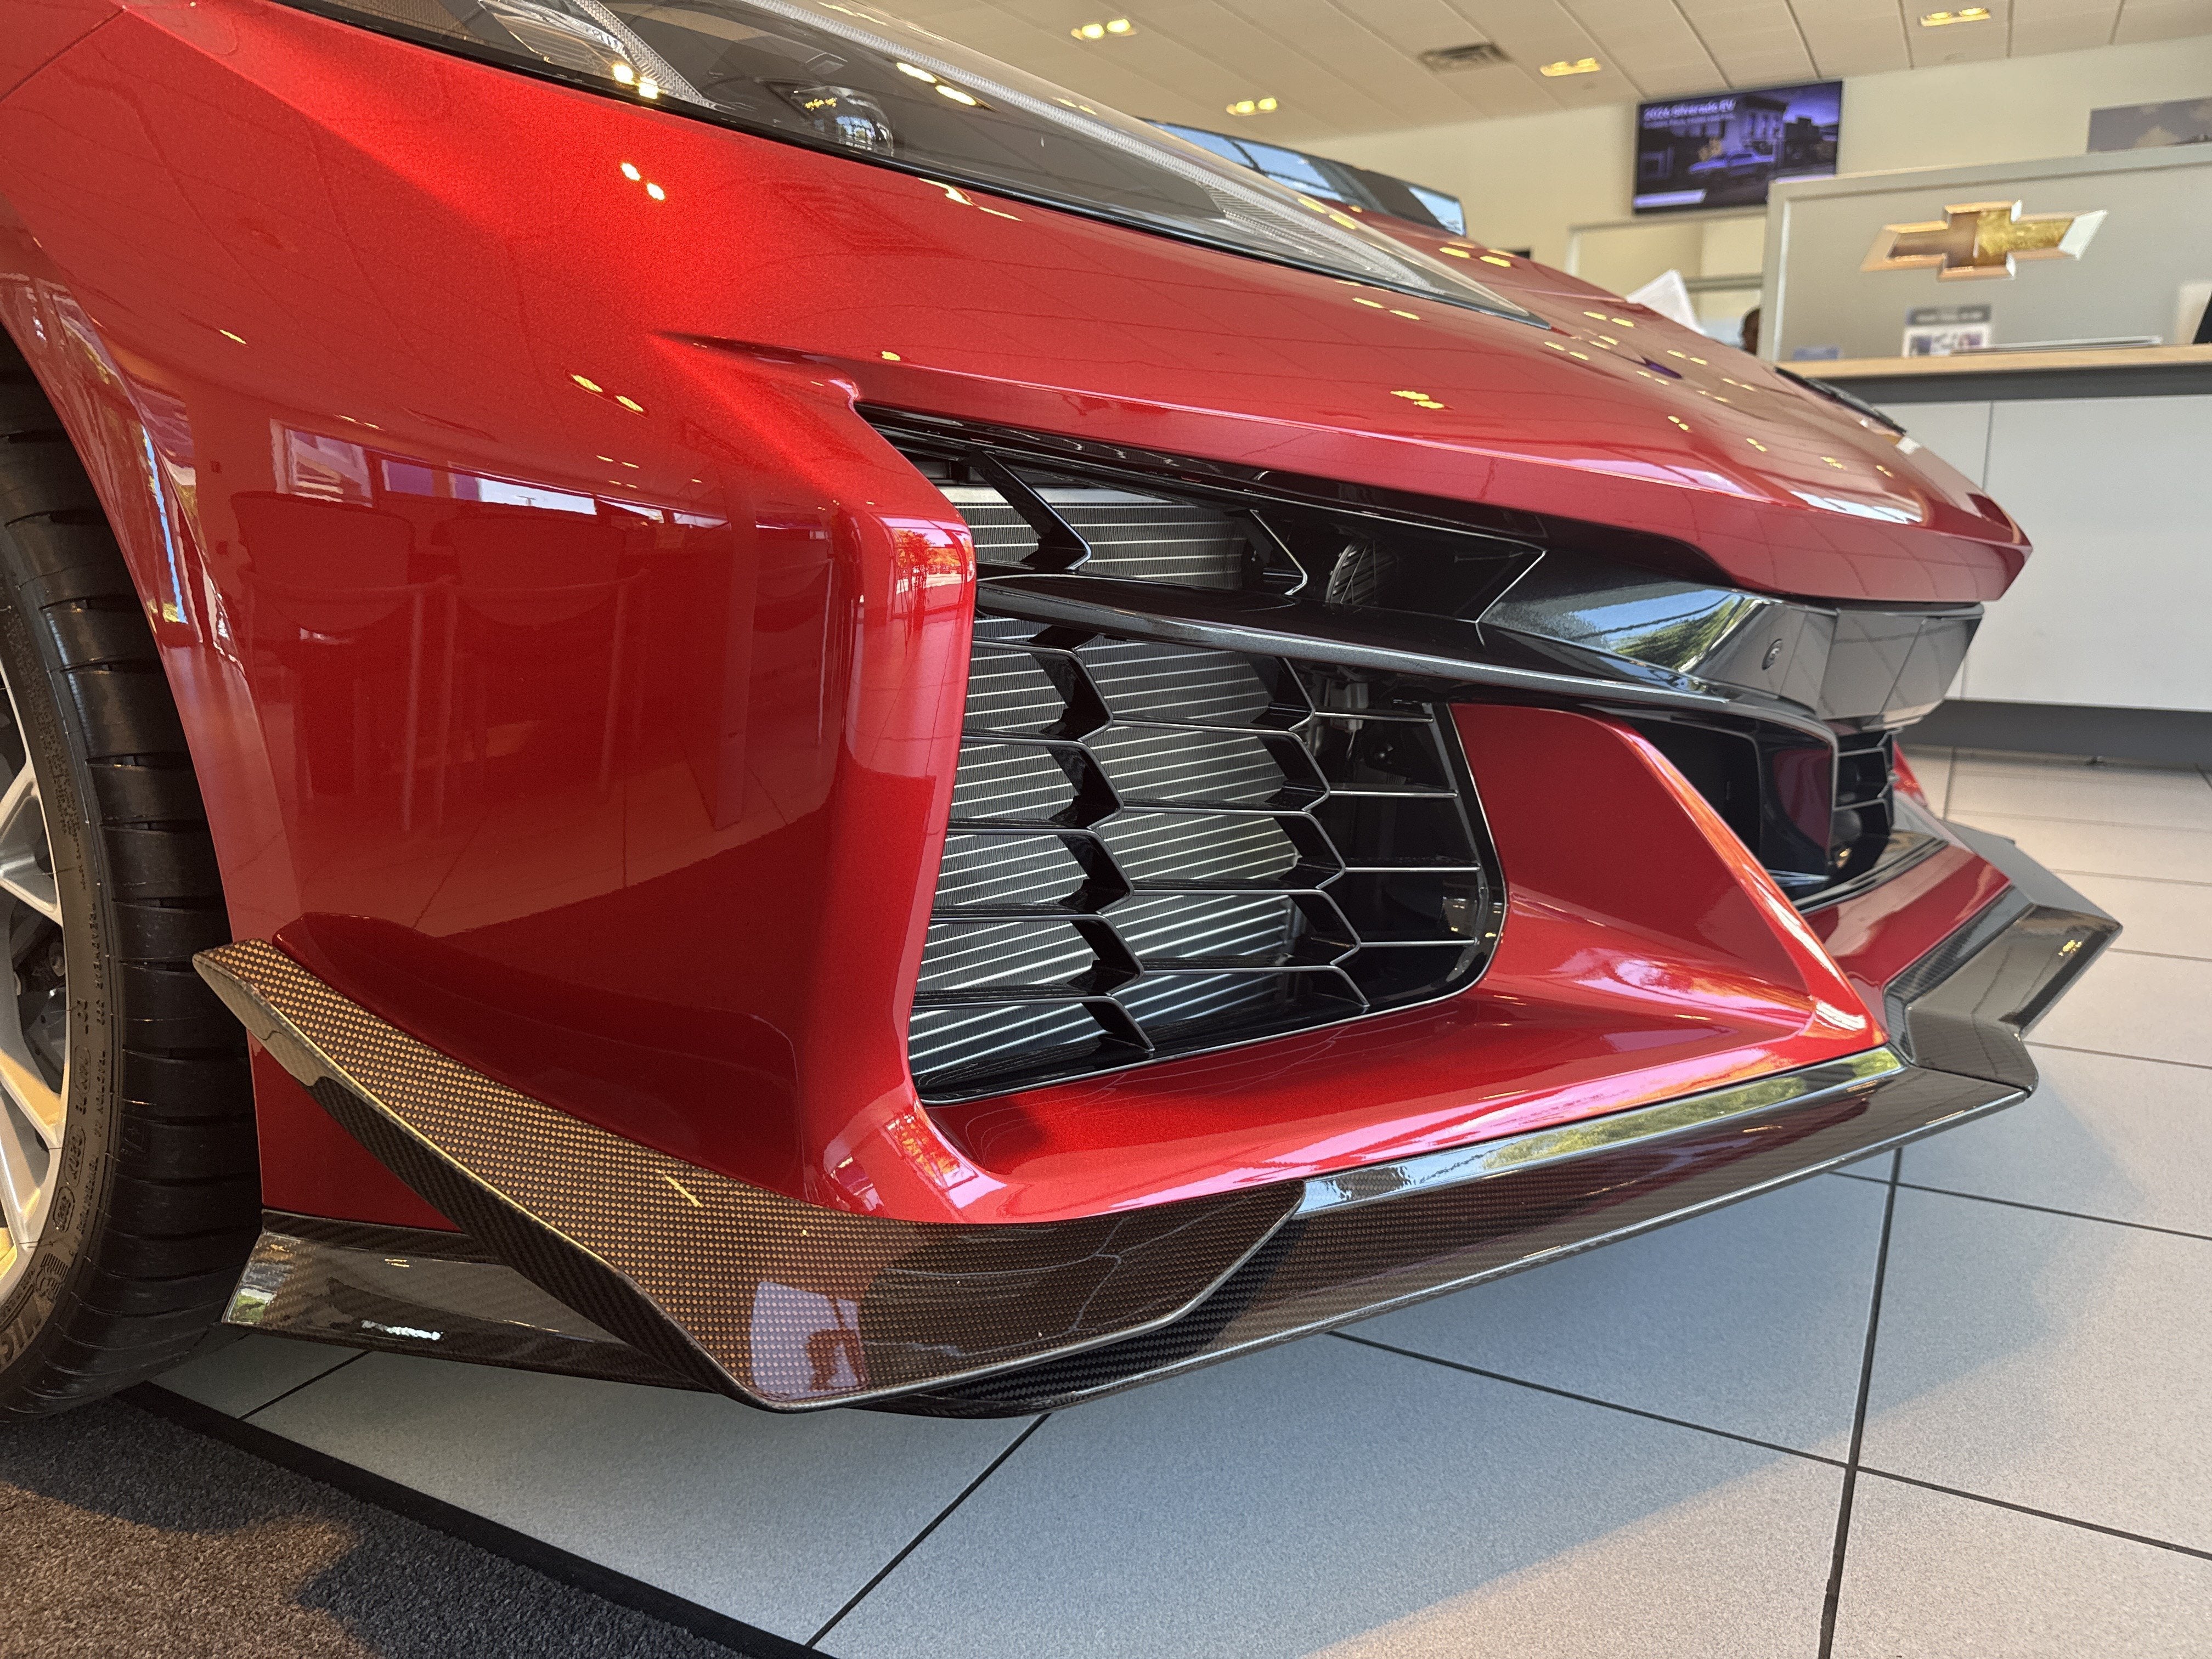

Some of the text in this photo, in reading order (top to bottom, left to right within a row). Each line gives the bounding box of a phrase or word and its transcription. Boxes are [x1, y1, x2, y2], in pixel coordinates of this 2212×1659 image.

[89, 902, 104, 990] TREADWEAR
[77, 999, 89, 1035] DOT
[95, 1051, 106, 1114] TRACTION
